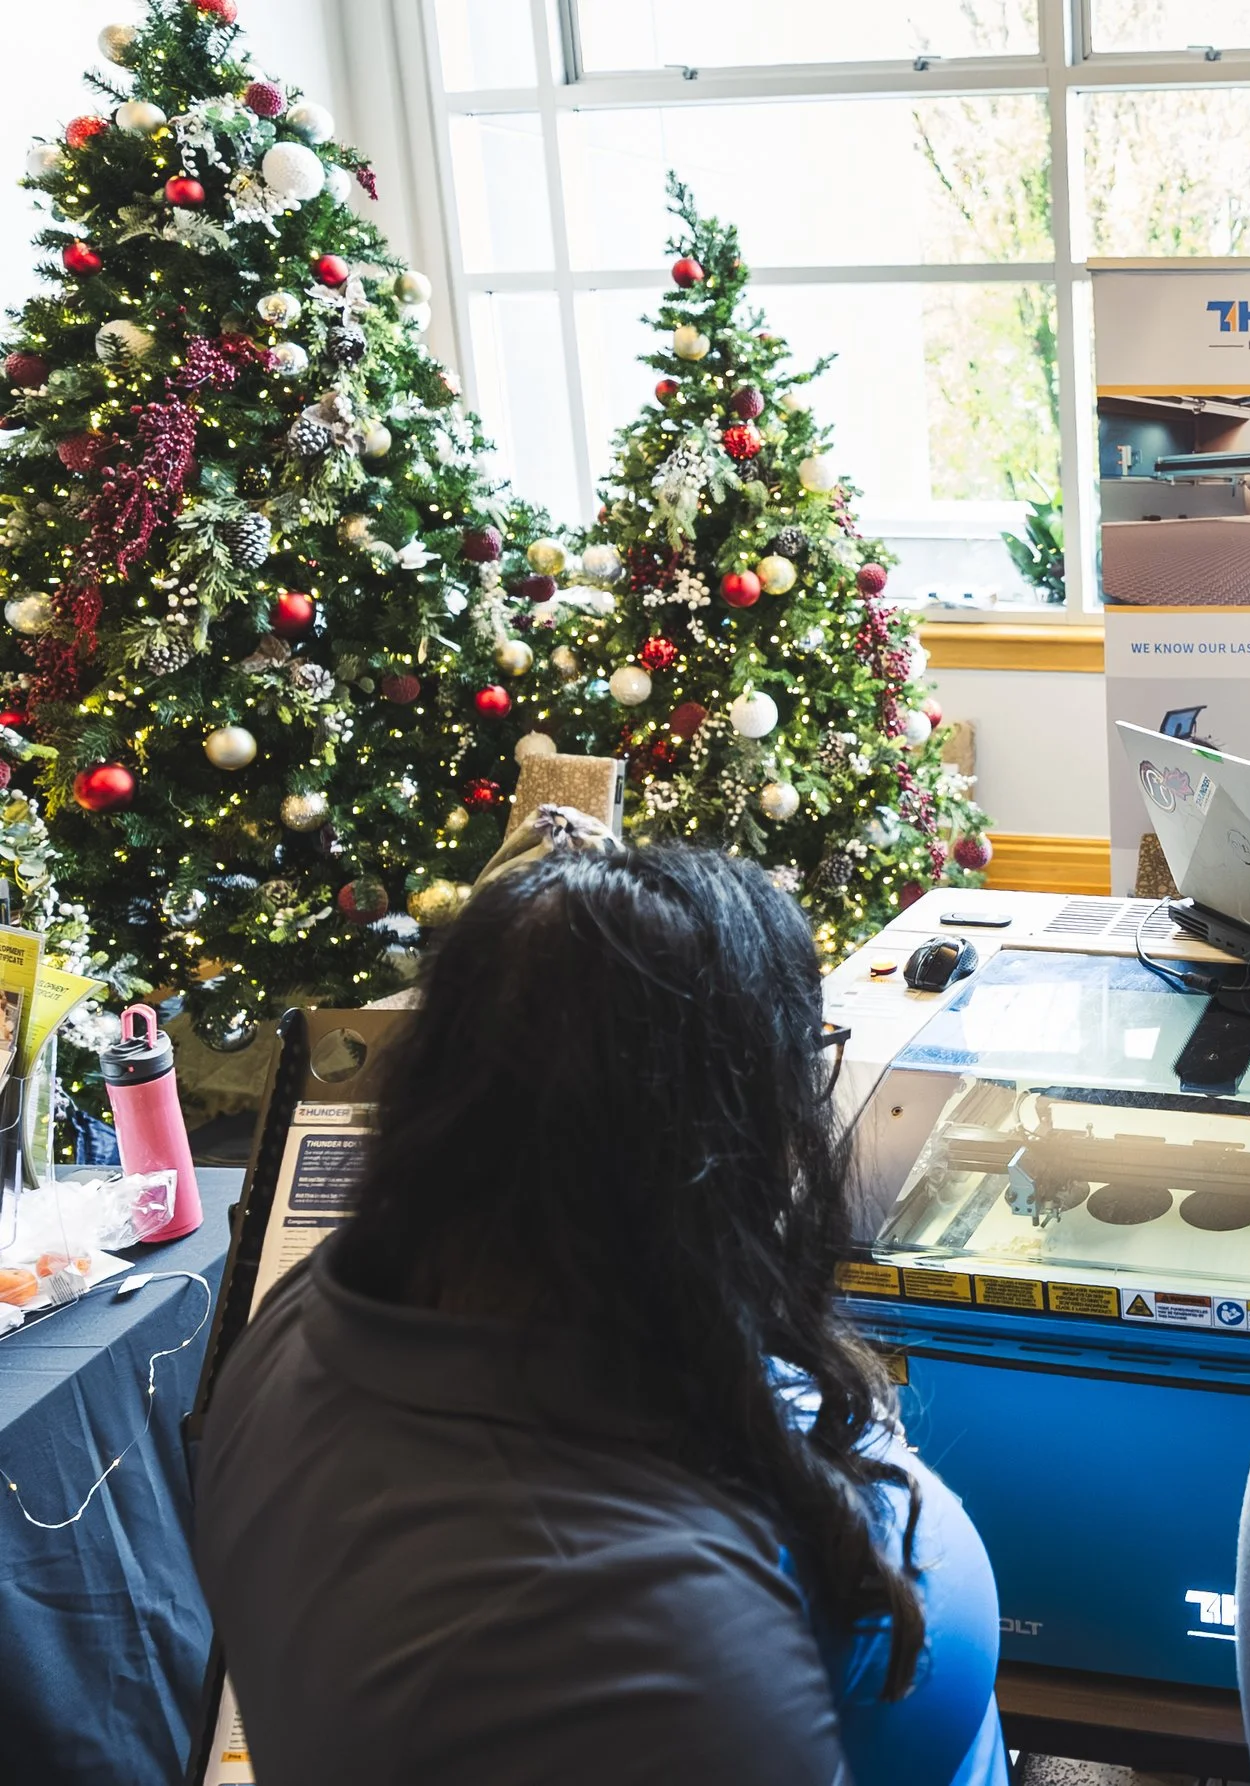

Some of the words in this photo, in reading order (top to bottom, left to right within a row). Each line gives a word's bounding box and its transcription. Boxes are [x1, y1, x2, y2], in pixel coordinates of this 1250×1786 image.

[1131, 643, 1150, 654] WE
[1154, 643, 1194, 654] KNOW
[1198, 643, 1226, 654] OUR
[298, 1107, 351, 1117] THUNDER
